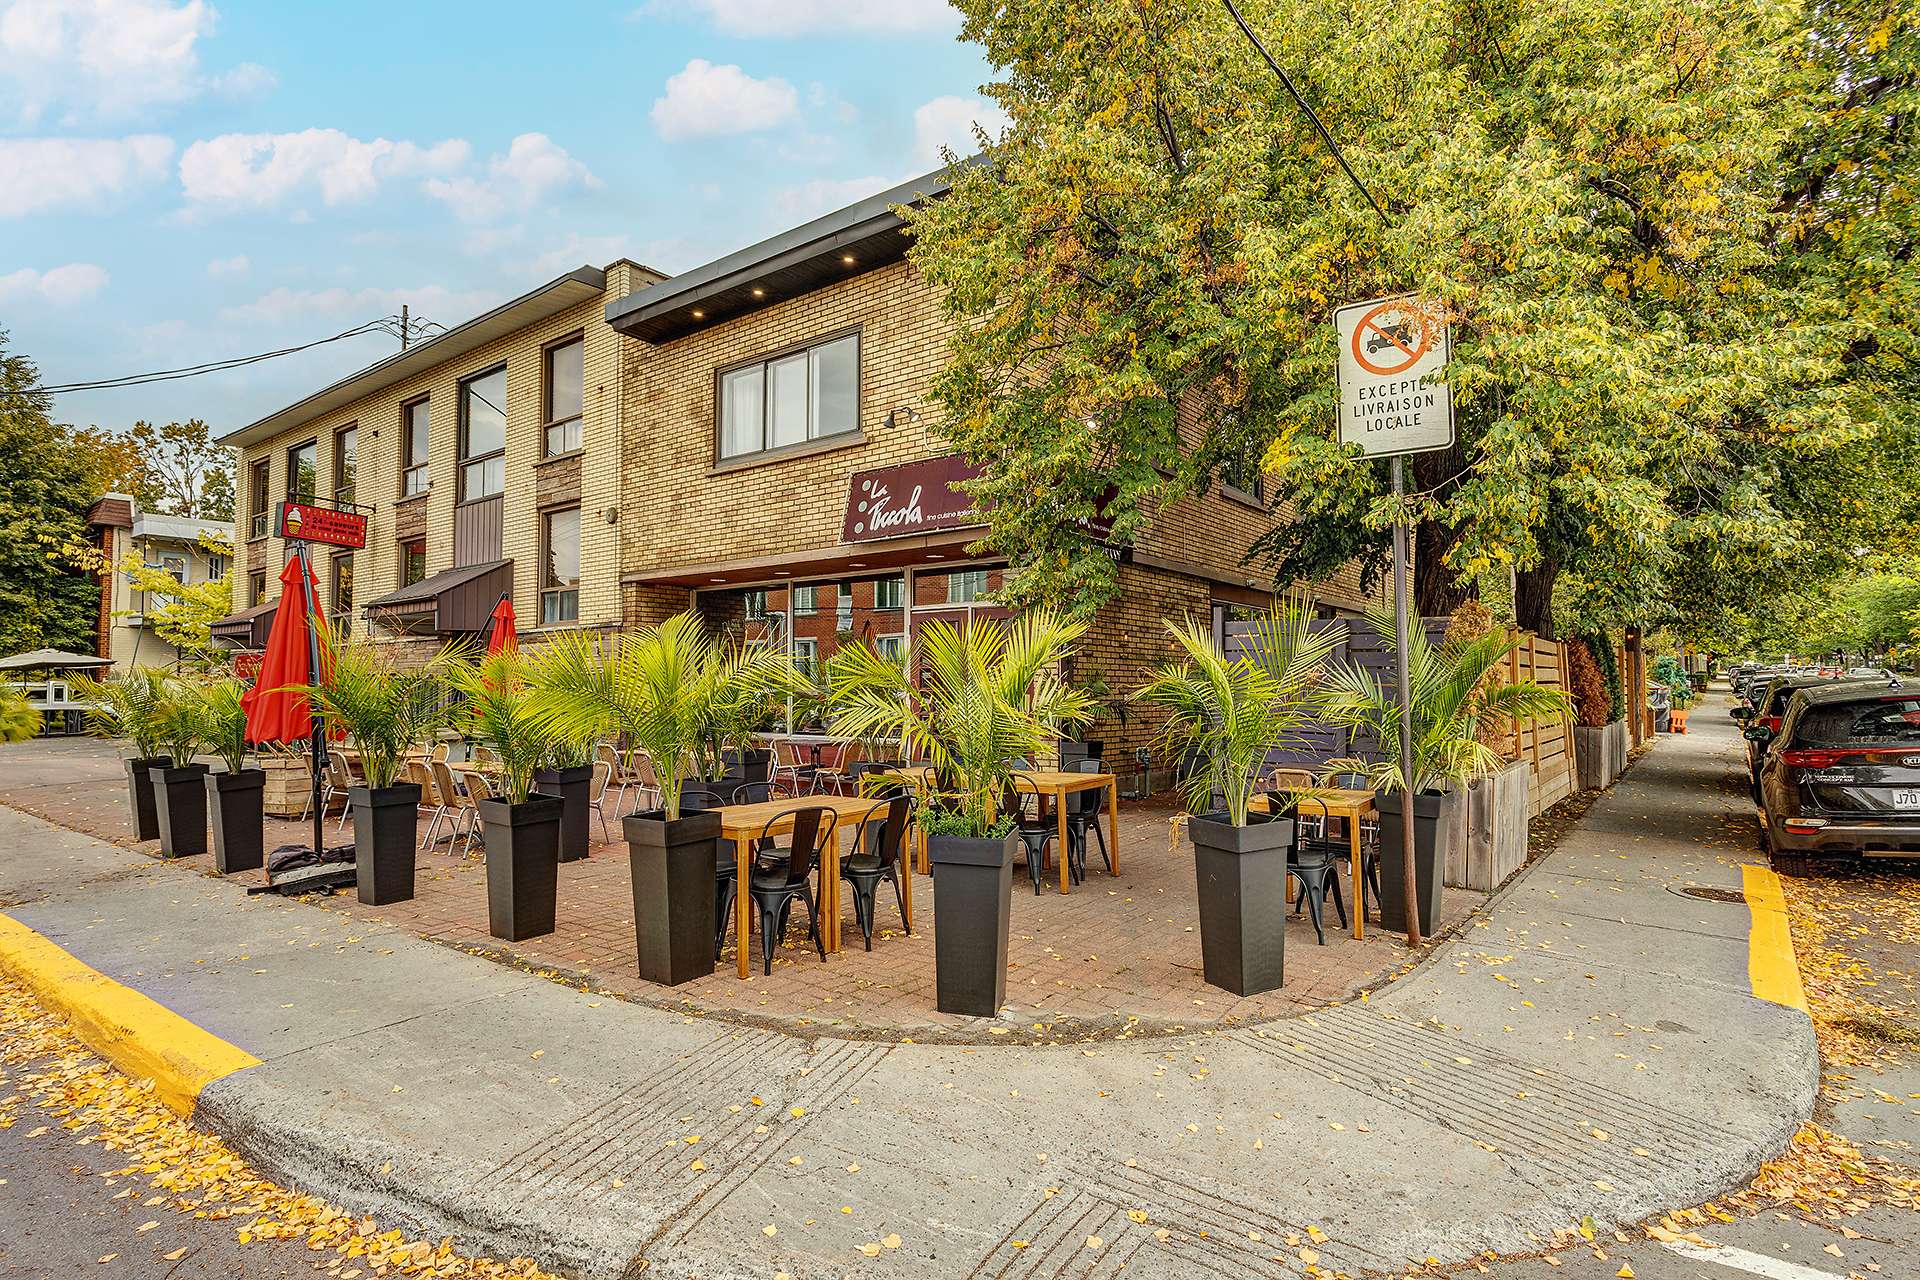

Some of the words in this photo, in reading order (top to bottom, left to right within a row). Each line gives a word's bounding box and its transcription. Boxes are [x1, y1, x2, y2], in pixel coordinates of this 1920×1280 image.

[1353, 394, 1434, 417] LIVRAISON
[1366, 413, 1421, 432] LOCALE
[870, 480, 888, 499] La
[1896, 793, 1918, 805] J70
